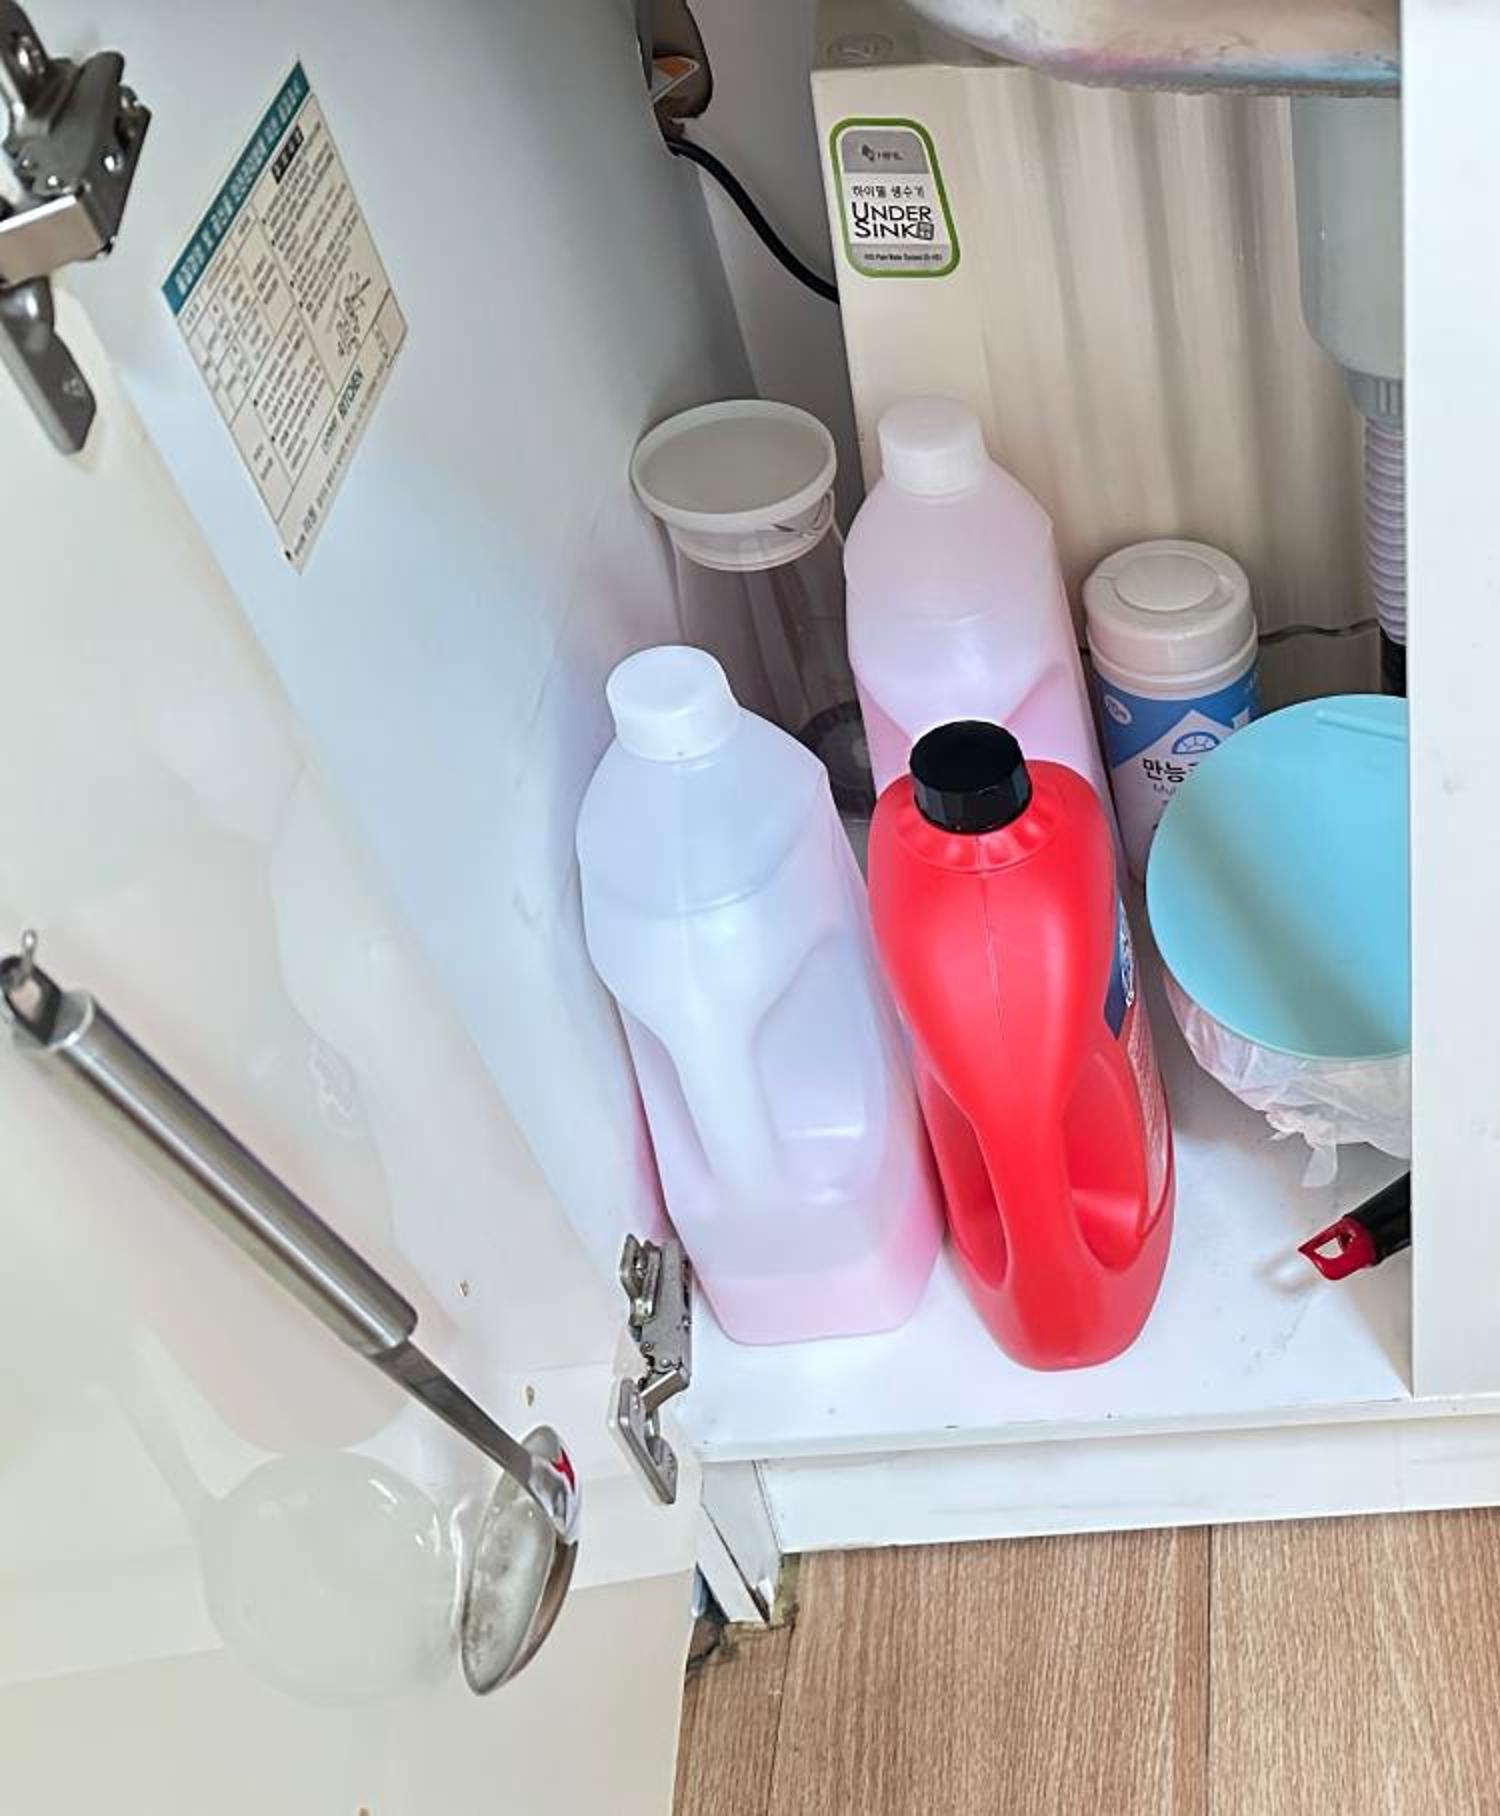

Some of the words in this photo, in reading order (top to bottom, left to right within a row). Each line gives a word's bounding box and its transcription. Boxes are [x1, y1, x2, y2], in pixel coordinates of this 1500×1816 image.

[852, 202, 932, 222] UNDER
[855, 221, 918, 239] SINK
[1142, 758, 1199, 783] 만능
